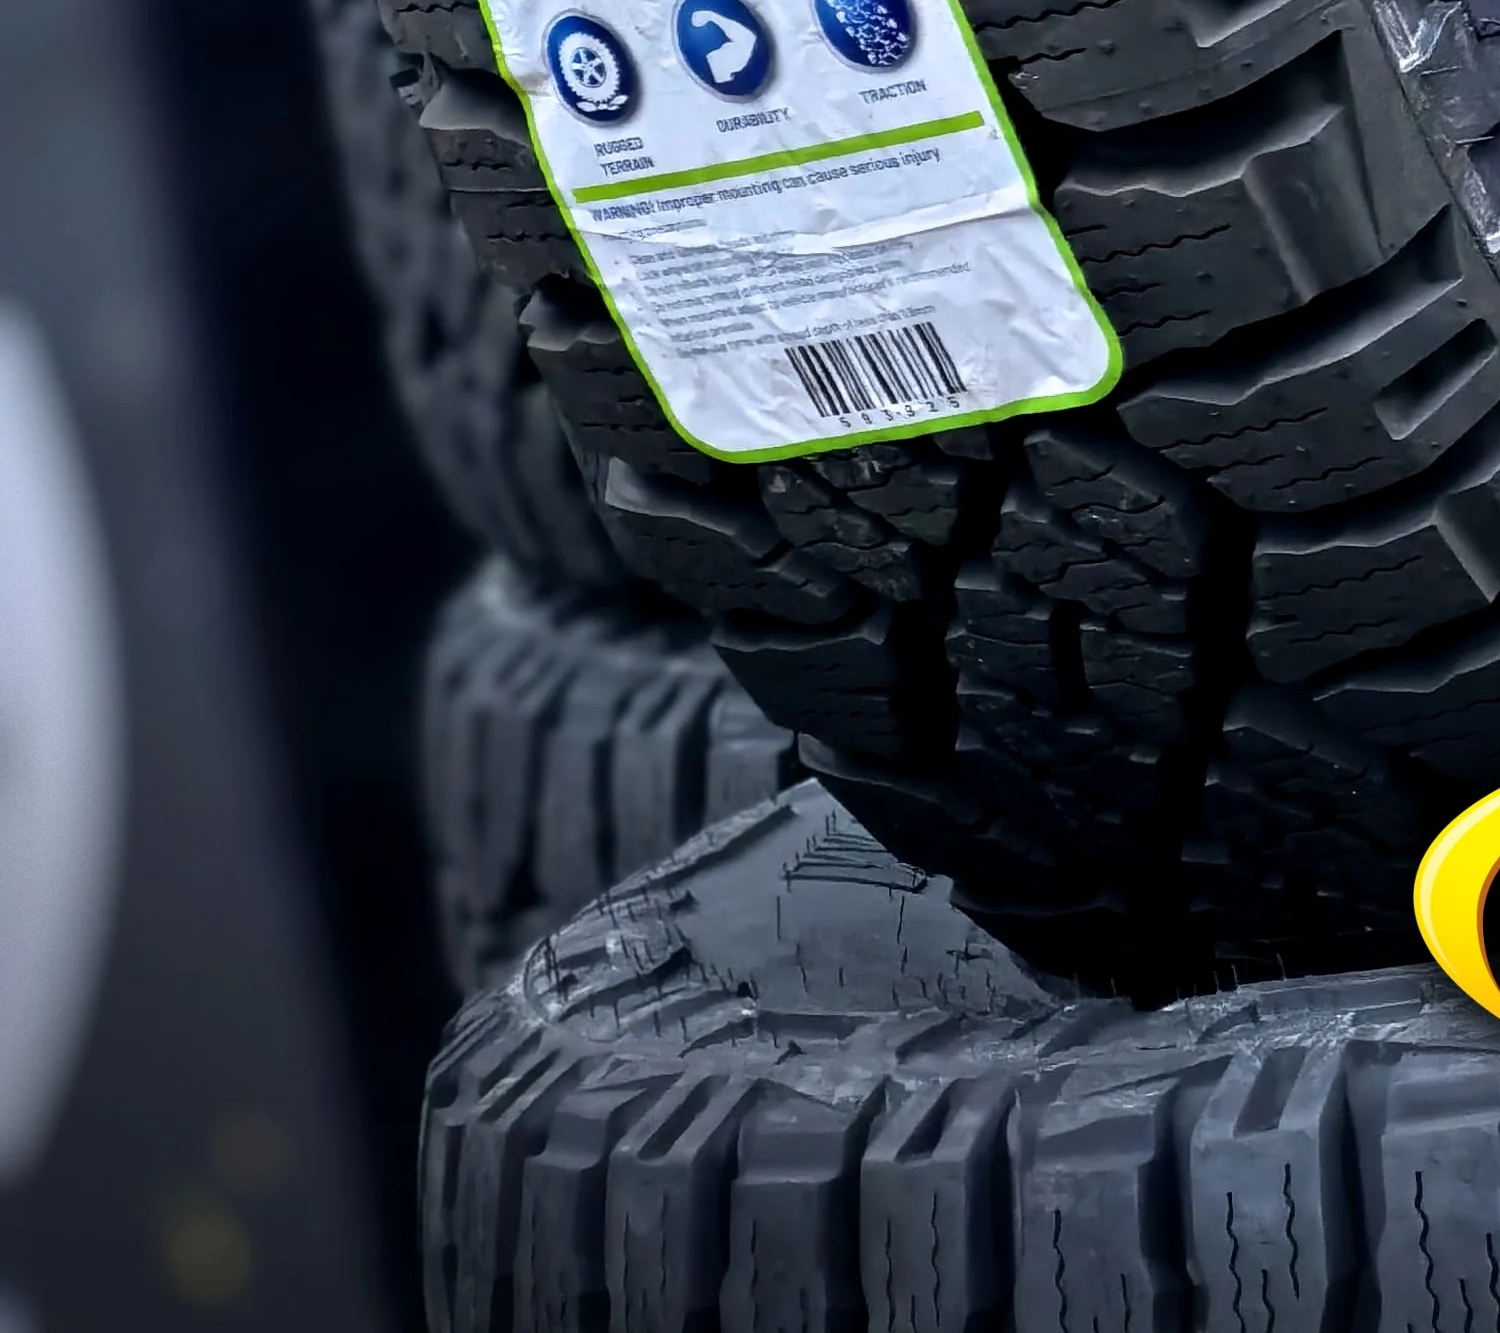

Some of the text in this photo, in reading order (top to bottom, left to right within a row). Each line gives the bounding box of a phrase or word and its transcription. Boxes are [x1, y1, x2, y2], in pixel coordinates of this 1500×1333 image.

[858, 80, 928, 104] TRACTION
[715, 107, 790, 133] DURABILITY
[594, 136, 644, 157] RUGGED
[600, 155, 656, 178] TERRAIN
[806, 167, 849, 187] cause
[848, 157, 900, 178] serious
[900, 147, 942, 173] injury
